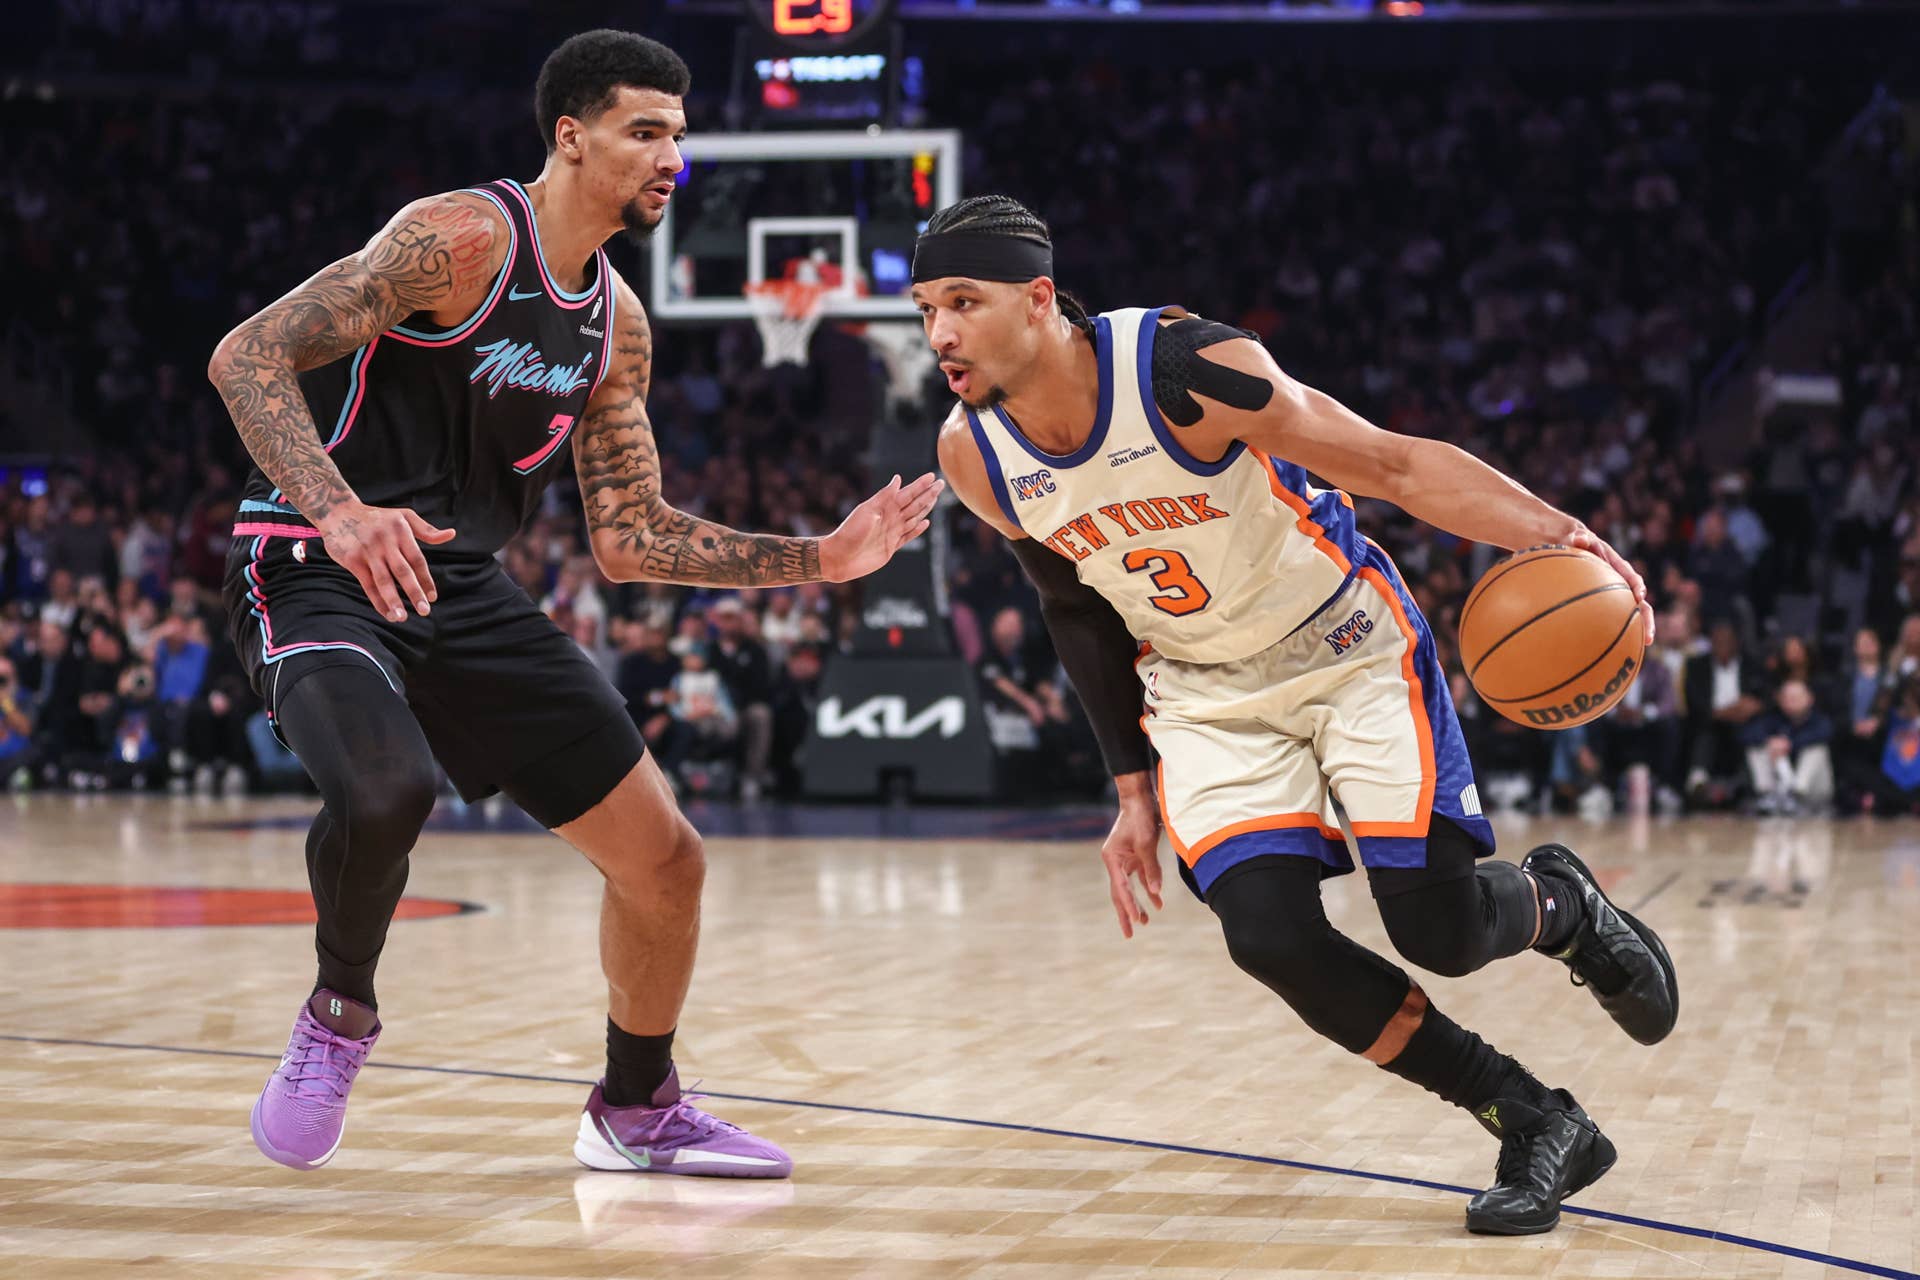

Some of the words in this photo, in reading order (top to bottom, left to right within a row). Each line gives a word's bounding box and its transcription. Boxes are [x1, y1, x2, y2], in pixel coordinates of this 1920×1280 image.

[389, 221, 453, 292] EAST
[416, 203, 492, 298] UMBLE
[470, 337, 593, 399] Miami
[513, 413, 575, 475] 7
[1110, 457, 1129, 468] abu
[1129, 443, 1158, 461] dhabi
[1010, 469, 1057, 501] NYC
[1097, 493, 1231, 537] YORK
[1122, 547, 1212, 618] 3
[1325, 610, 1374, 655] NYC
[1521, 656, 1636, 725] Wilson
